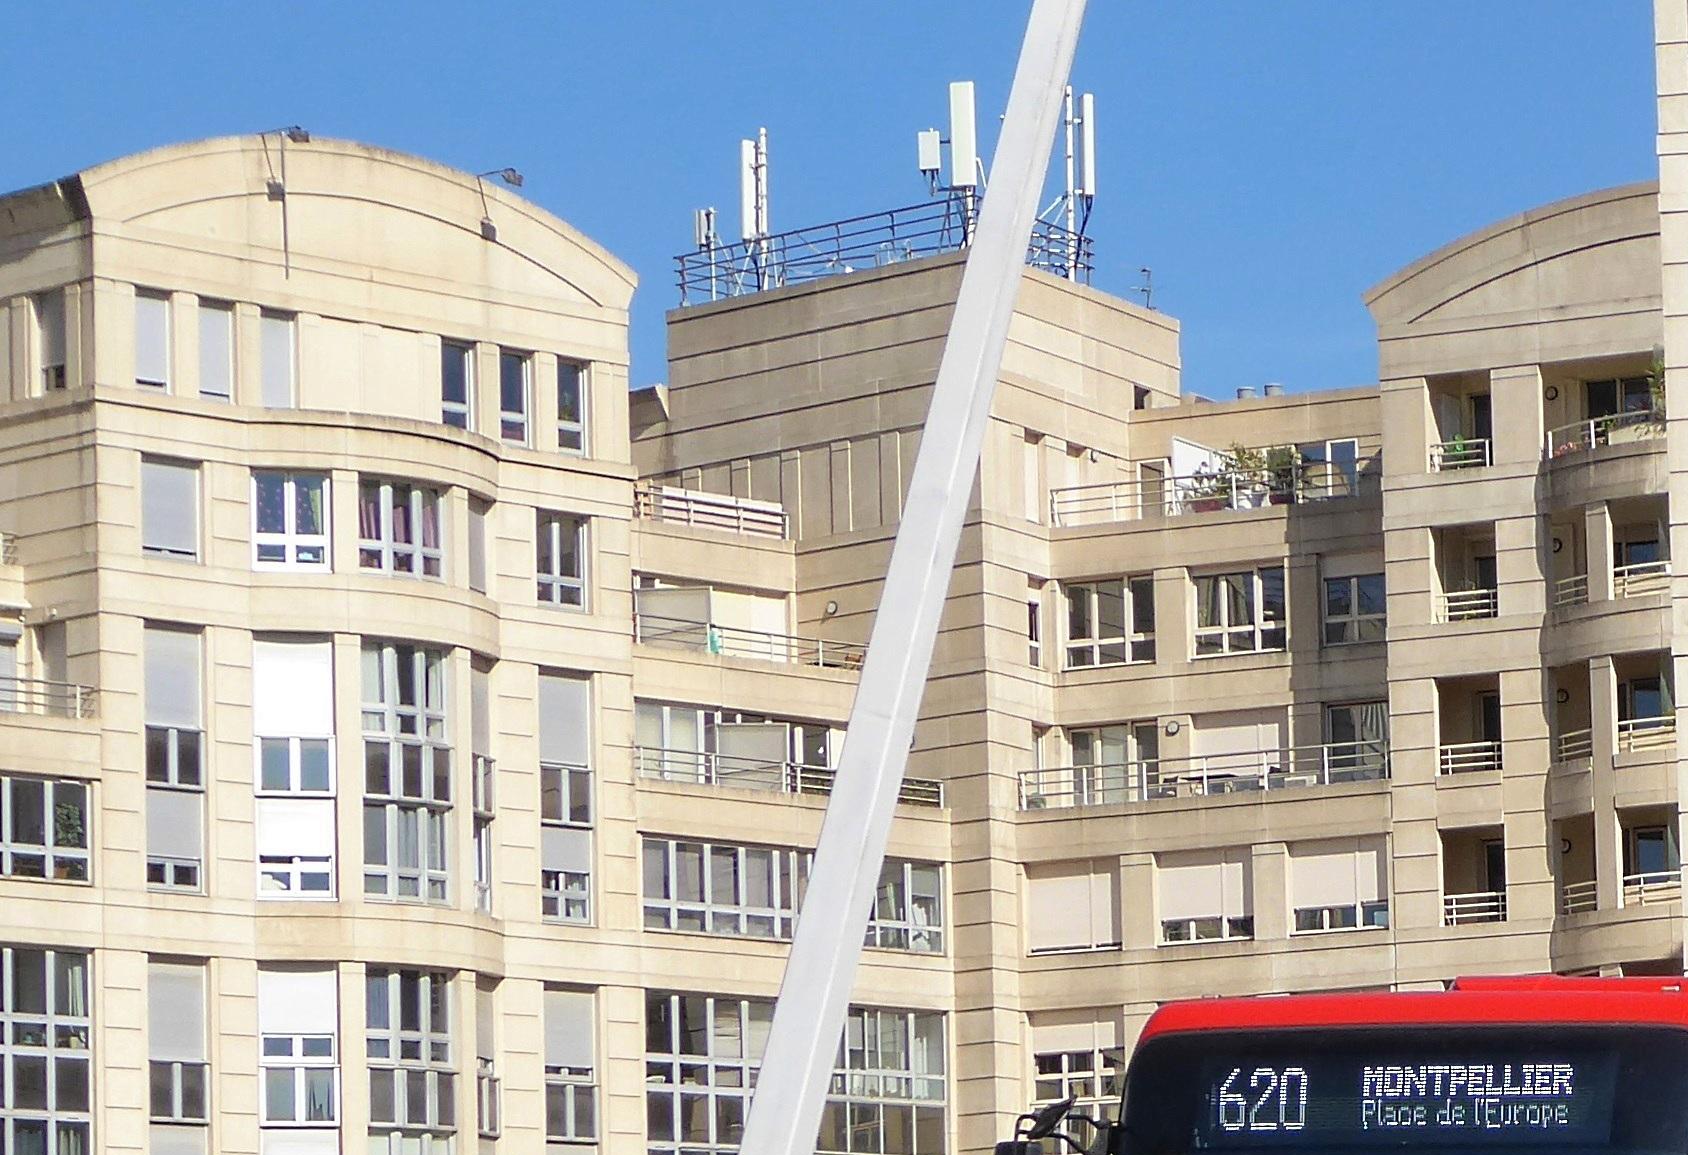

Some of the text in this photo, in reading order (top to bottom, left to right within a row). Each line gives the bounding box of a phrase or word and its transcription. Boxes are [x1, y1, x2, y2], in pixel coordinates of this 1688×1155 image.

[1363, 1064, 1574, 1097] MONTPELLIER
[1219, 1067, 1307, 1130] 620
[1363, 1098, 1569, 1129] Place de l'Europe
